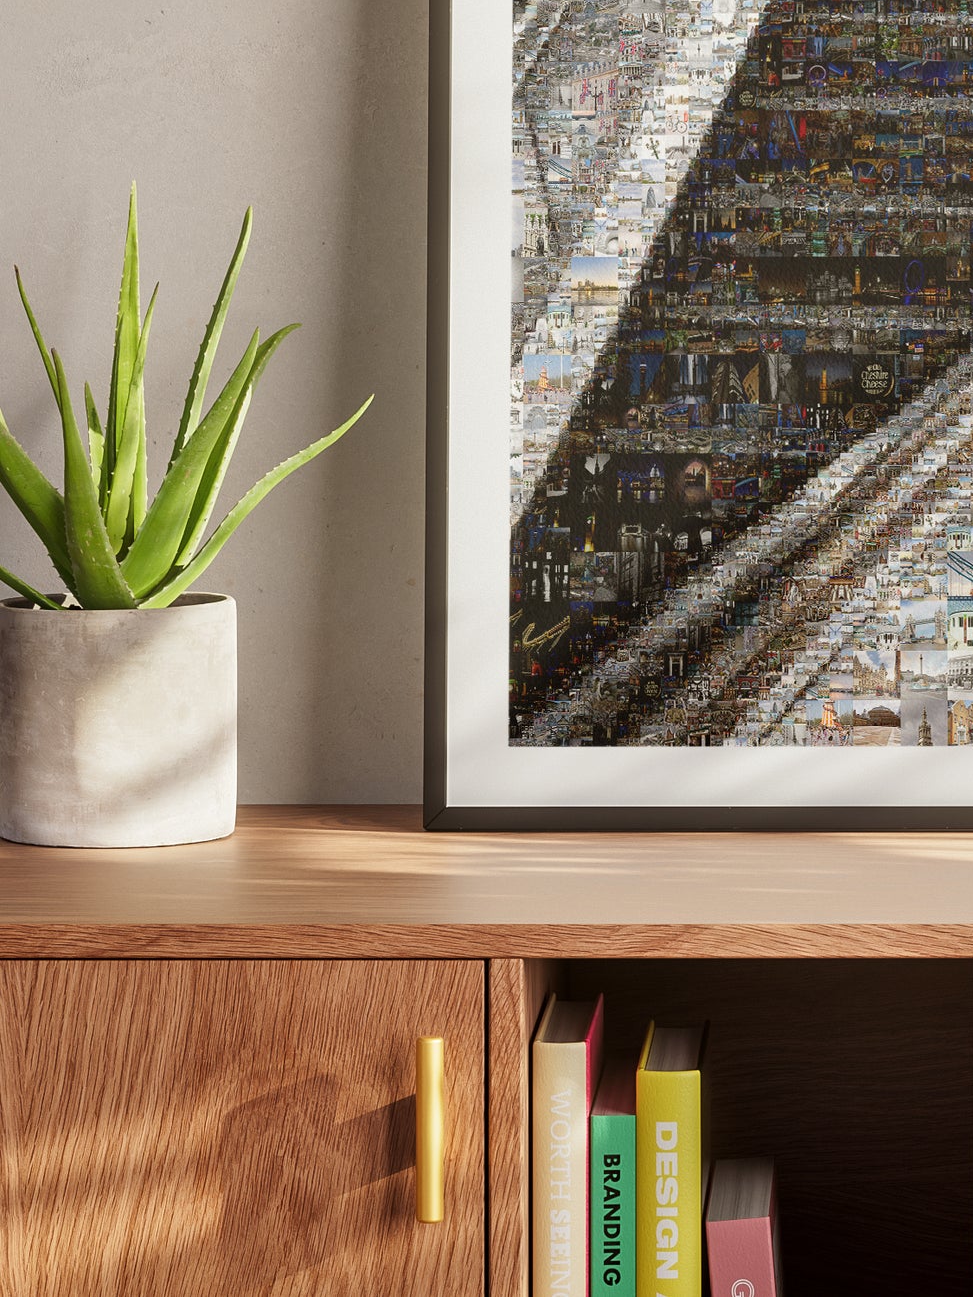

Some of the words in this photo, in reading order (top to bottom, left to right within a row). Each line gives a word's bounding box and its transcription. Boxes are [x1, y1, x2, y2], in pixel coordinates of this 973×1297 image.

[550, 1088, 571, 1201] WORTH
[656, 1121, 678, 1279] DESIGN
[603, 1154, 621, 1286] BRANDING
